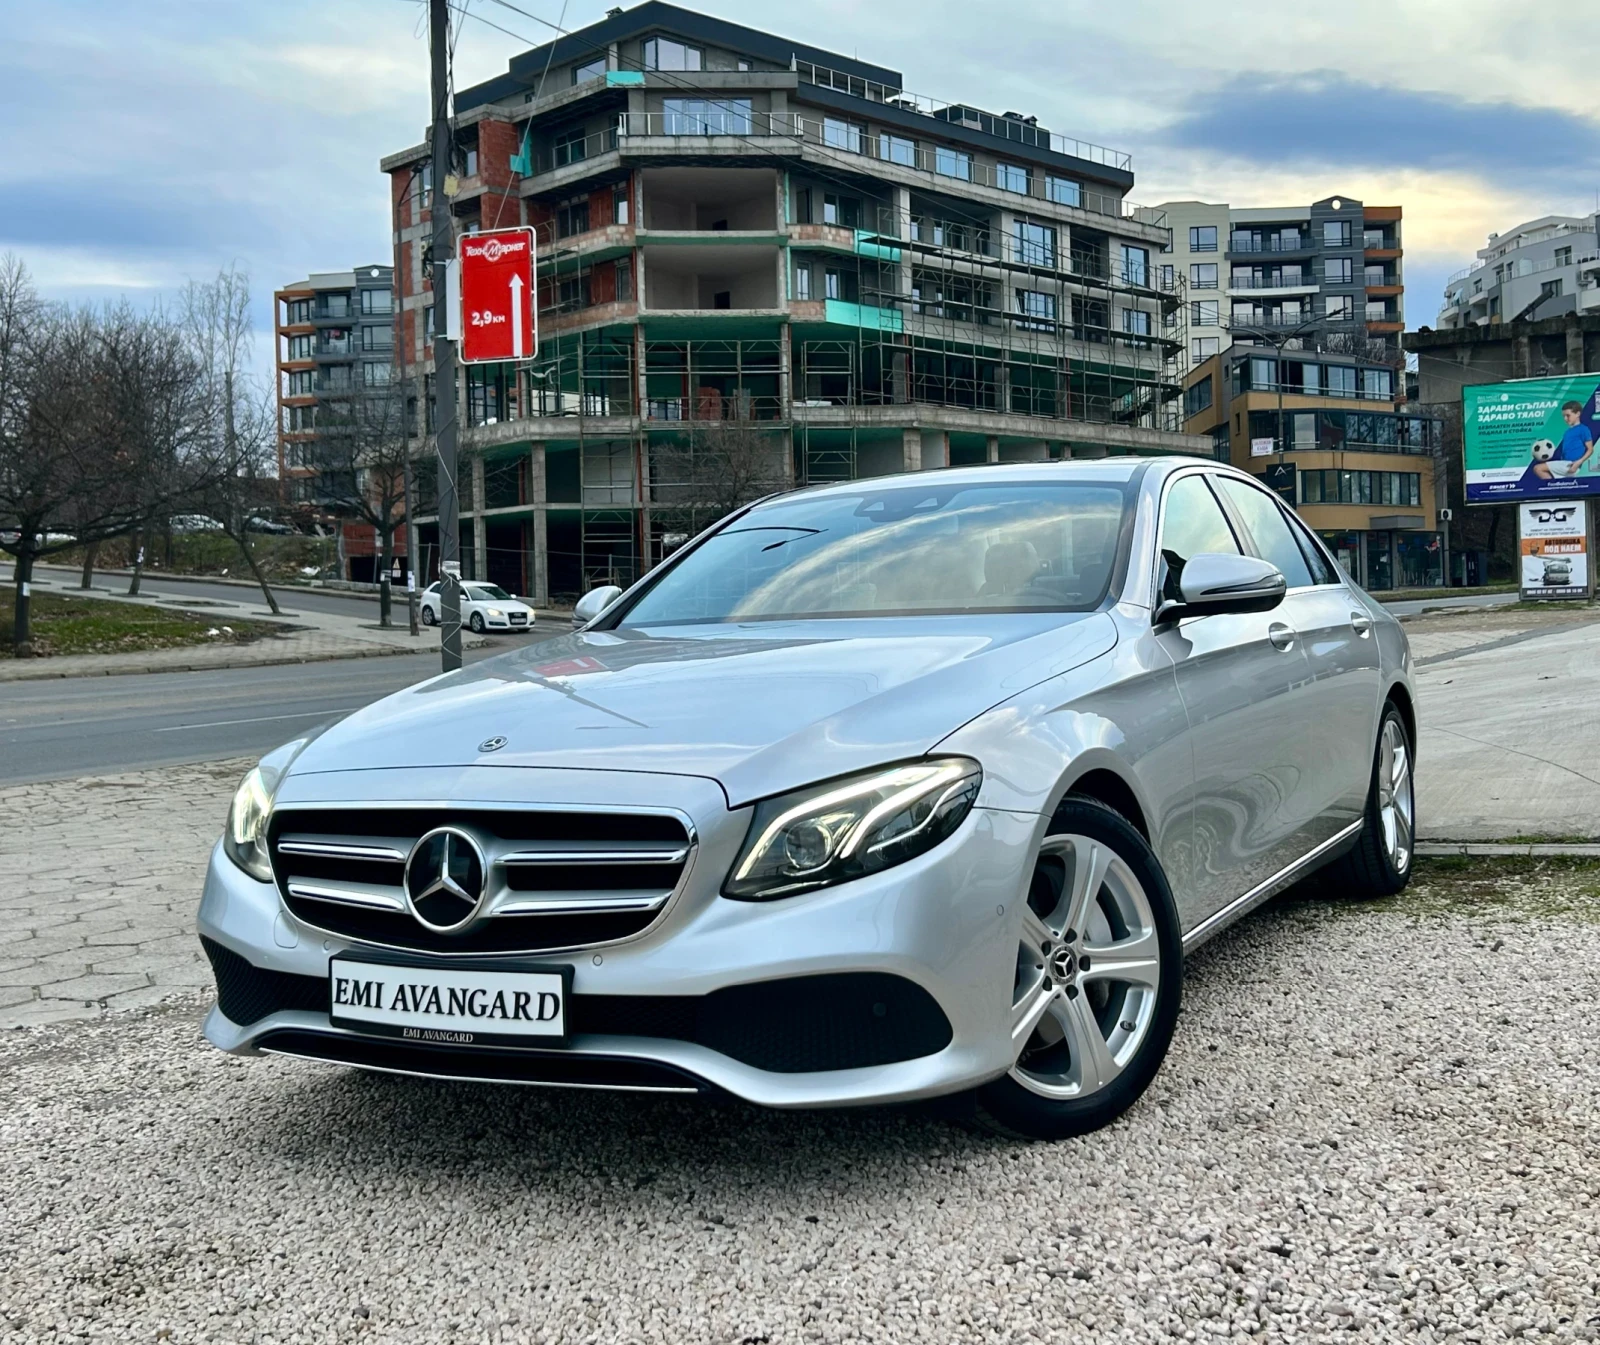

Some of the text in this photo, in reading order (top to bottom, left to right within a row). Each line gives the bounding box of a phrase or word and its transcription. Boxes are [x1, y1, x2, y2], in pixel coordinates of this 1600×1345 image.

[1477, 400, 1559, 415] ЗДРАВИ СТЪПАЛА
[1477, 410, 1545, 423] ЗДРАВО ТЯЛО!
[1544, 543, 1582, 553] ПОД НАЕМ
[334, 977, 561, 1022] EMI AVANGARD
[402, 1028, 474, 1044] EMI AVANGARD
